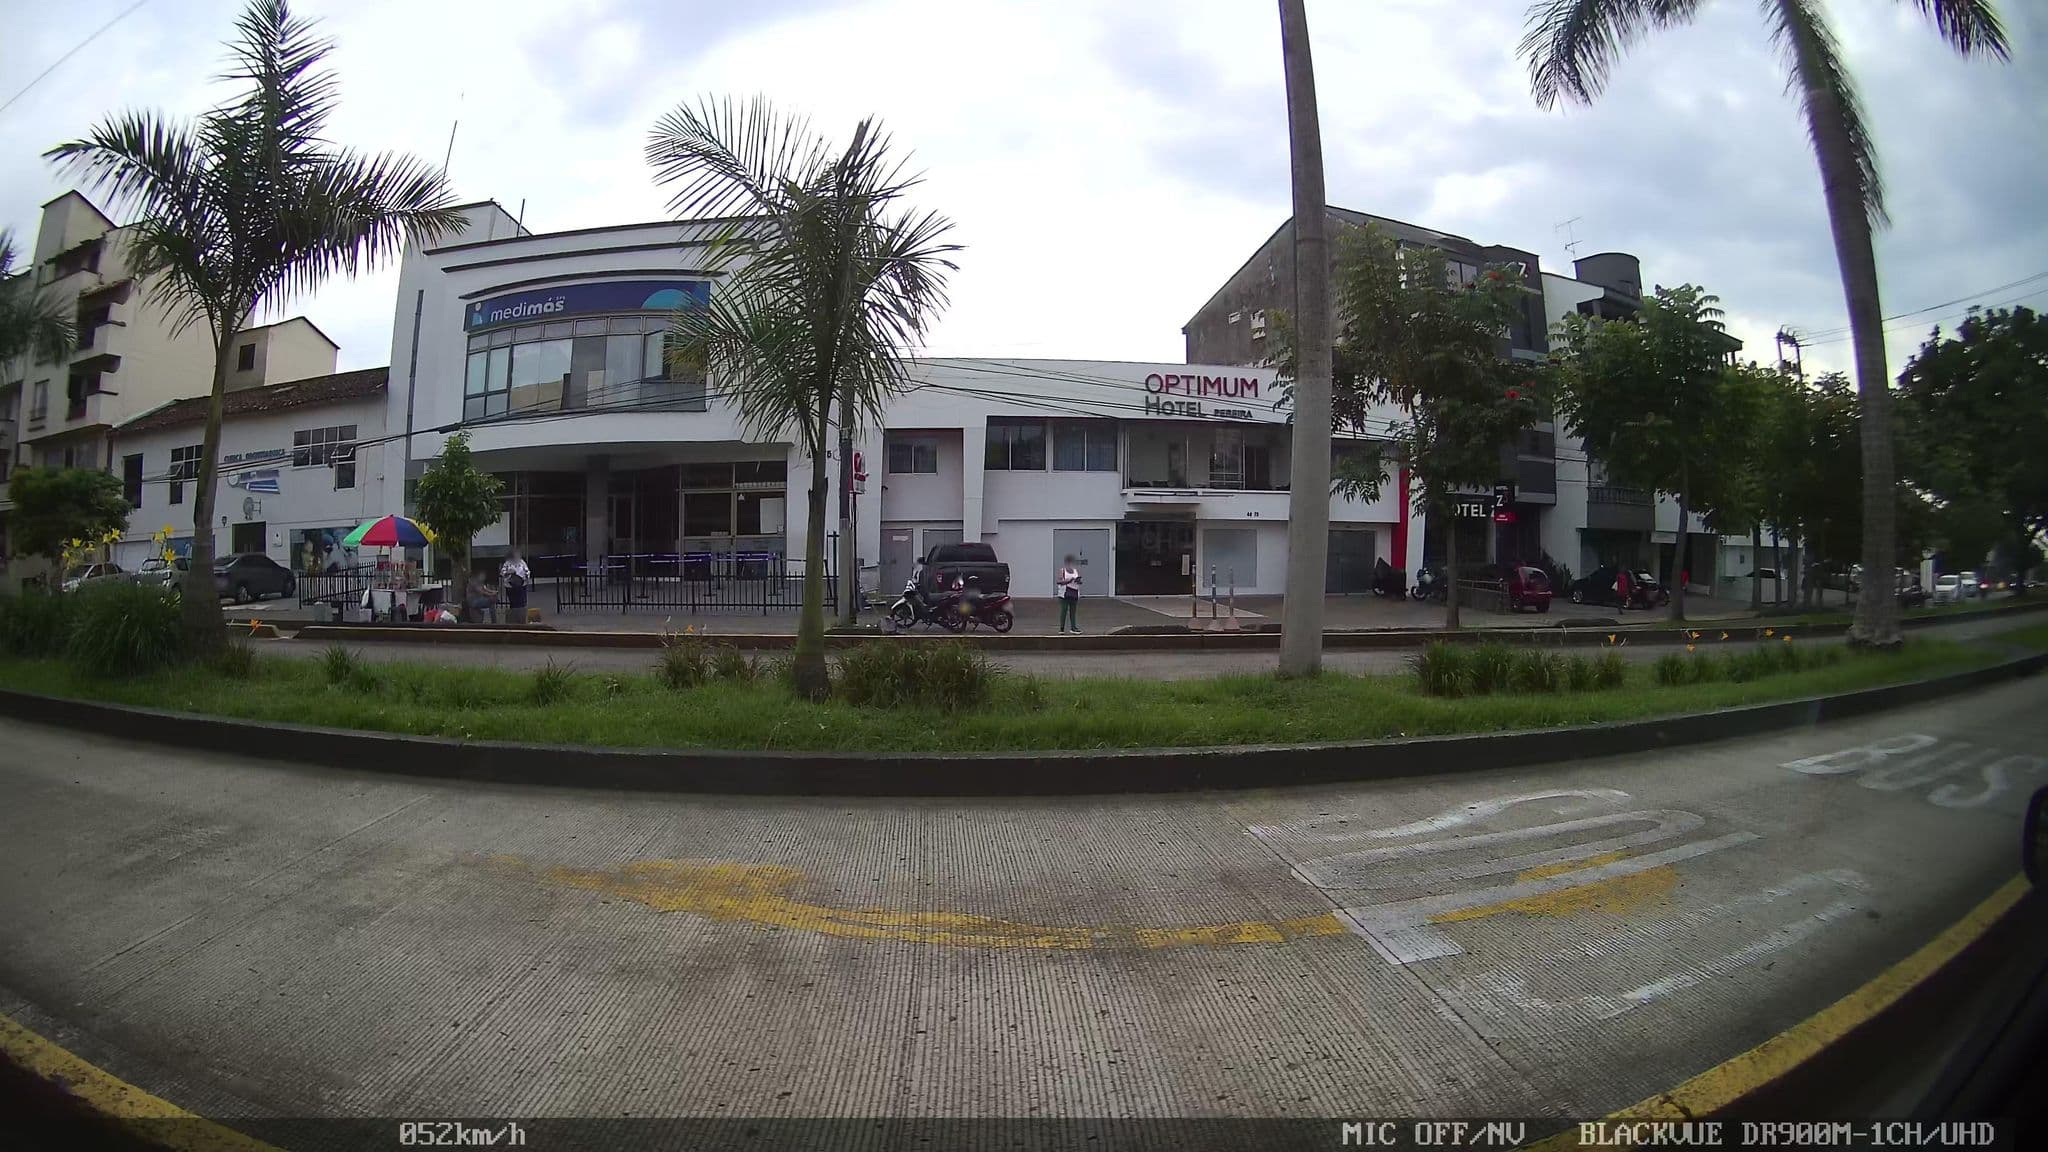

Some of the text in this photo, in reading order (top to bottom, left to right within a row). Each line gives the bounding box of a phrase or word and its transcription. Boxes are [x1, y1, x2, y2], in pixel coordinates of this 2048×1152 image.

[490, 298, 564, 323] medimás
[1144, 373, 1259, 398] OPTIMUM
[1144, 396, 1253, 418] HOTEL PEREIRA
[1777, 733, 2047, 809] BUS
